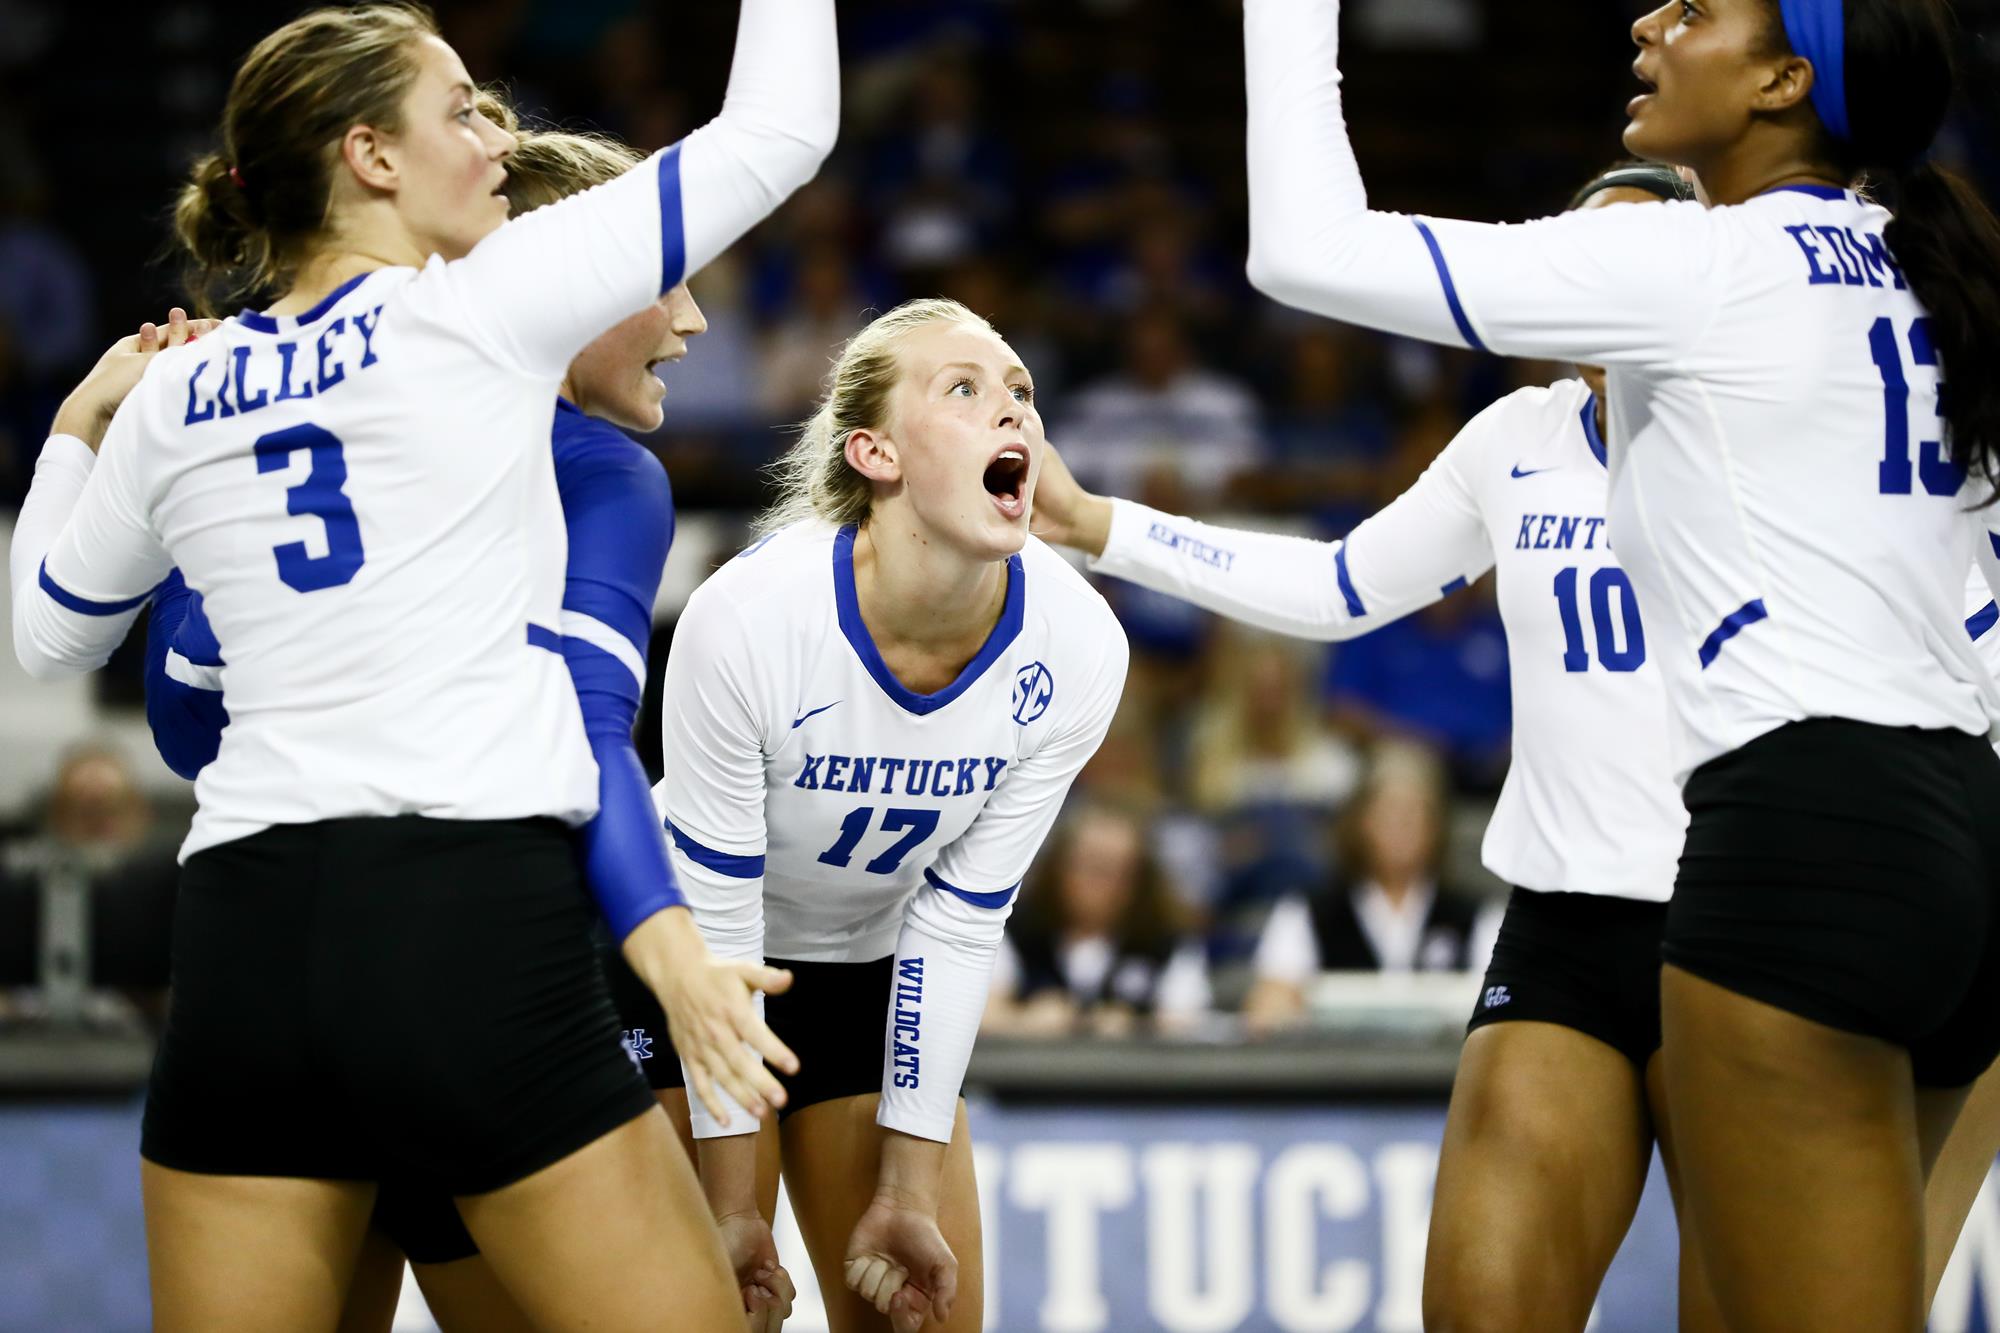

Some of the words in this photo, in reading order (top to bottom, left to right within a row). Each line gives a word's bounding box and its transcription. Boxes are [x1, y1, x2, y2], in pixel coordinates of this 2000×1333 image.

[184, 303, 384, 426] LILLEY
[1868, 317, 1967, 497] 13
[254, 422, 365, 593] 3
[1147, 521, 1236, 572] KENTUCKY
[1516, 514, 1612, 550] KENT
[1554, 567, 1646, 672] 10
[794, 753, 1008, 797] KENTUCKY
[817, 807, 941, 875] 17
[893, 957, 924, 1090] WILDCATS
